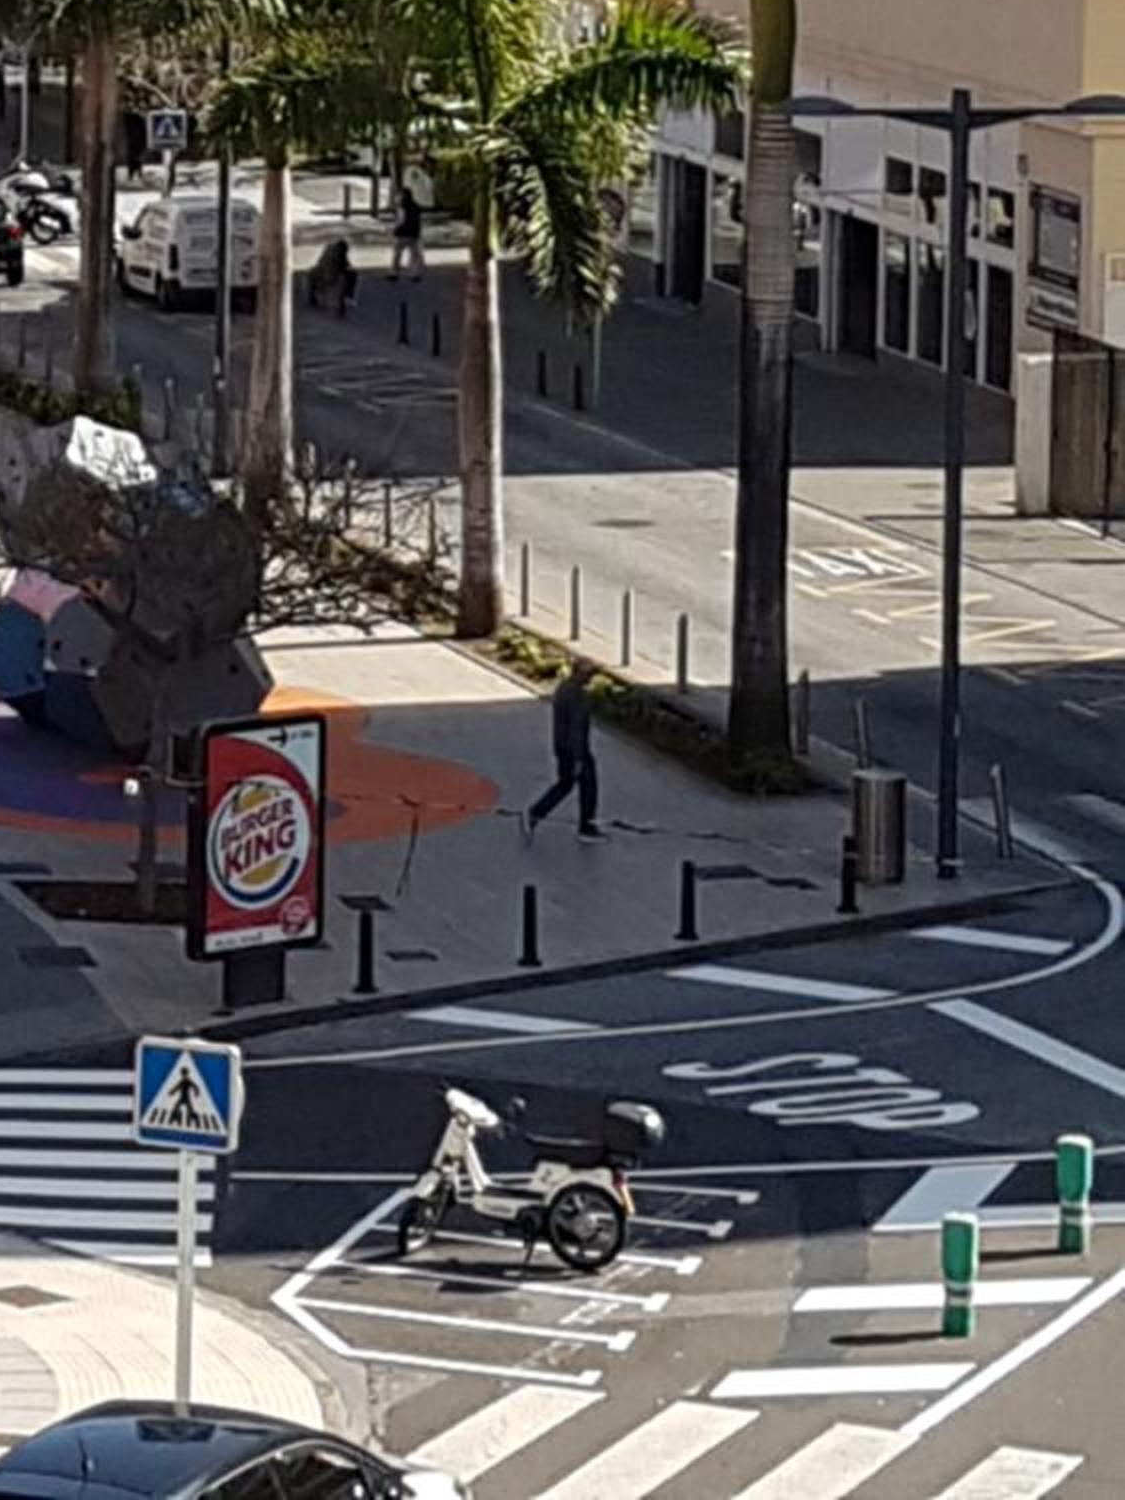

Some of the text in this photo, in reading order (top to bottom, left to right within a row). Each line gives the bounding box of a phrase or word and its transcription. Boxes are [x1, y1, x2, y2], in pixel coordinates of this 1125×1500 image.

[220, 798, 293, 850] BURGER
[225, 819, 296, 878] KING
[662, 1052, 980, 1130] STOP
